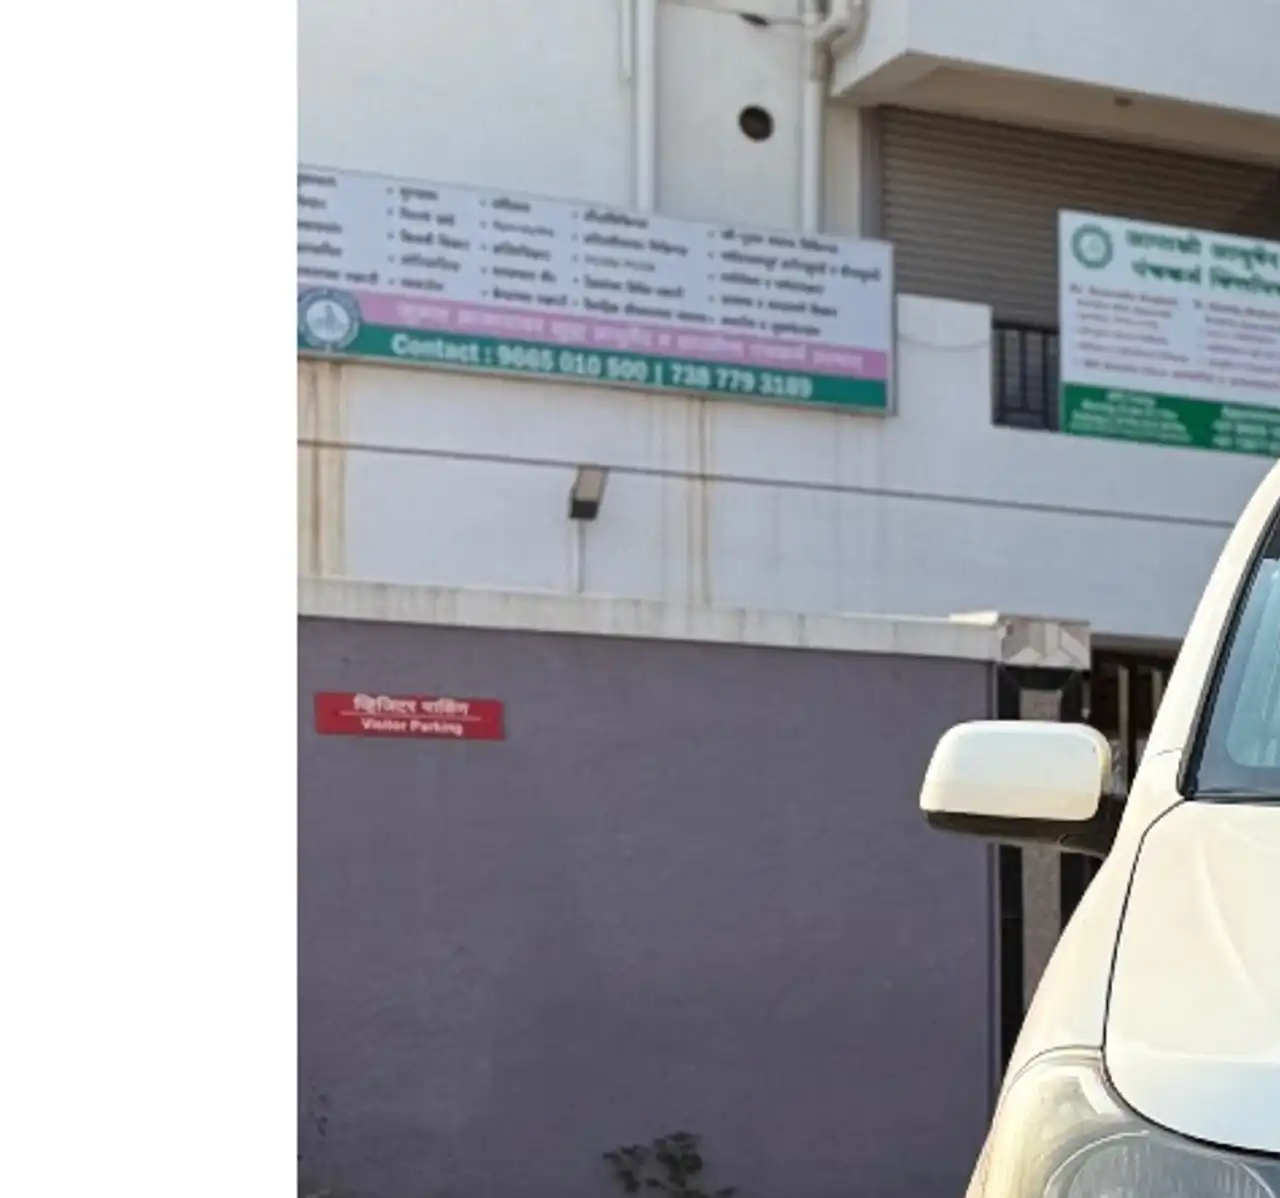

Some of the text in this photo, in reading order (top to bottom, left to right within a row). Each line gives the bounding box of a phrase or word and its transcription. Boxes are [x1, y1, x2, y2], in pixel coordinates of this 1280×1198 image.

[391, 333, 479, 364] Contact
[361, 717, 464, 737] Visitor Parking
